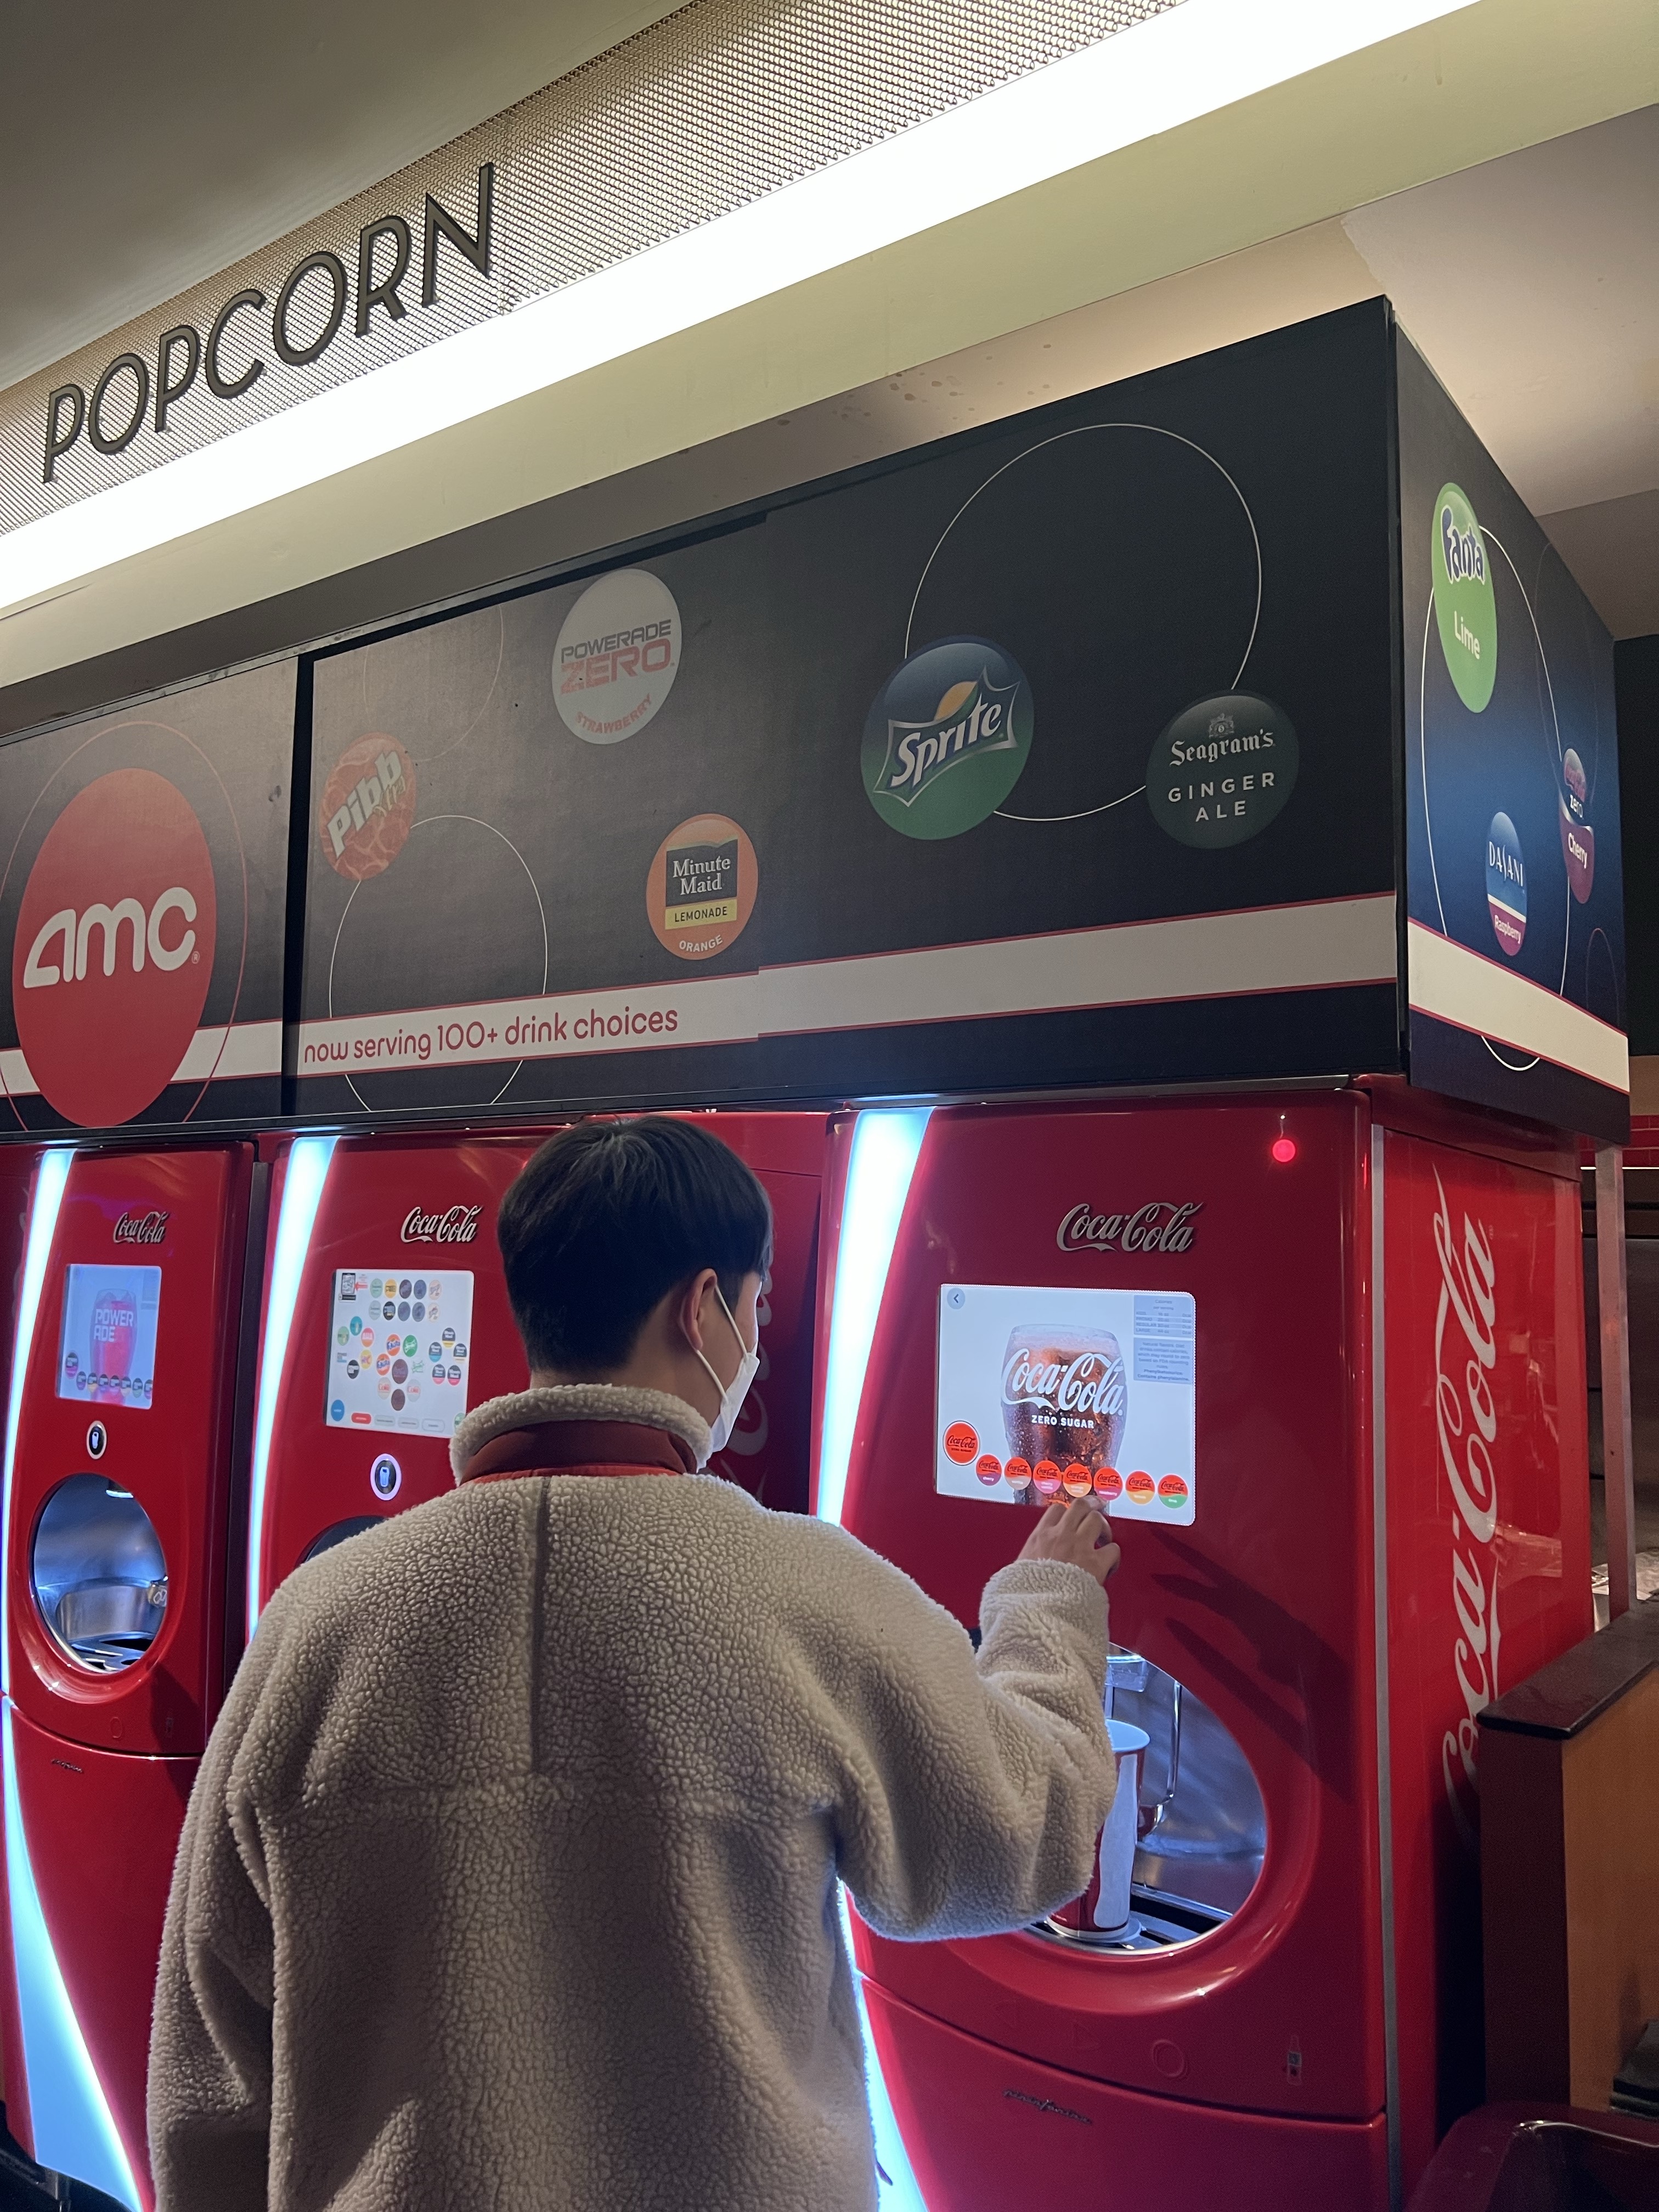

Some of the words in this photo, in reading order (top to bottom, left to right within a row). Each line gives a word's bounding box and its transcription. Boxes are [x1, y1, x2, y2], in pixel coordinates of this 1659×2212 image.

[43, 161, 494, 483] POPCORN
[1441, 504, 1486, 585] Fanta
[561, 619, 672, 663] POWERADE
[1454, 611, 1480, 659] Lime
[561, 638, 671, 695] ZERO
[576, 692, 651, 733] STRAWBERRY
[890, 692, 1002, 787] Sprite
[1170, 729, 1273, 766] Seagram's
[327, 751, 402, 859] Pibb
[1169, 772, 1274, 802] GINGER
[1195, 800, 1245, 822] ALE
[673, 855, 731, 878] Minute
[1489, 841, 1523, 887] DASANI
[1568, 832, 1587, 869] Cherry
[680, 873, 723, 895] Maid
[675, 906, 727, 922] LEMONADE
[679, 935, 723, 952] ORANGE
[304, 1041, 349, 1063] now
[354, 1029, 431, 1060] serving
[438, 1021, 499, 1051] 100+
[505, 1012, 567, 1045] drink
[573, 1006, 679, 1040] choices
[400, 1205, 483, 1243] Coca-Cola
[1056, 1201, 1204, 1252] Coca-Cola
[93, 1325, 116, 1342] ADE
[95, 1308, 134, 1327] POWER
[1001, 1348, 1124, 1415] Coca-Cola
[1031, 1415, 1057, 1425] ZERO
[1060, 1418, 1094, 1429] SUGAR
